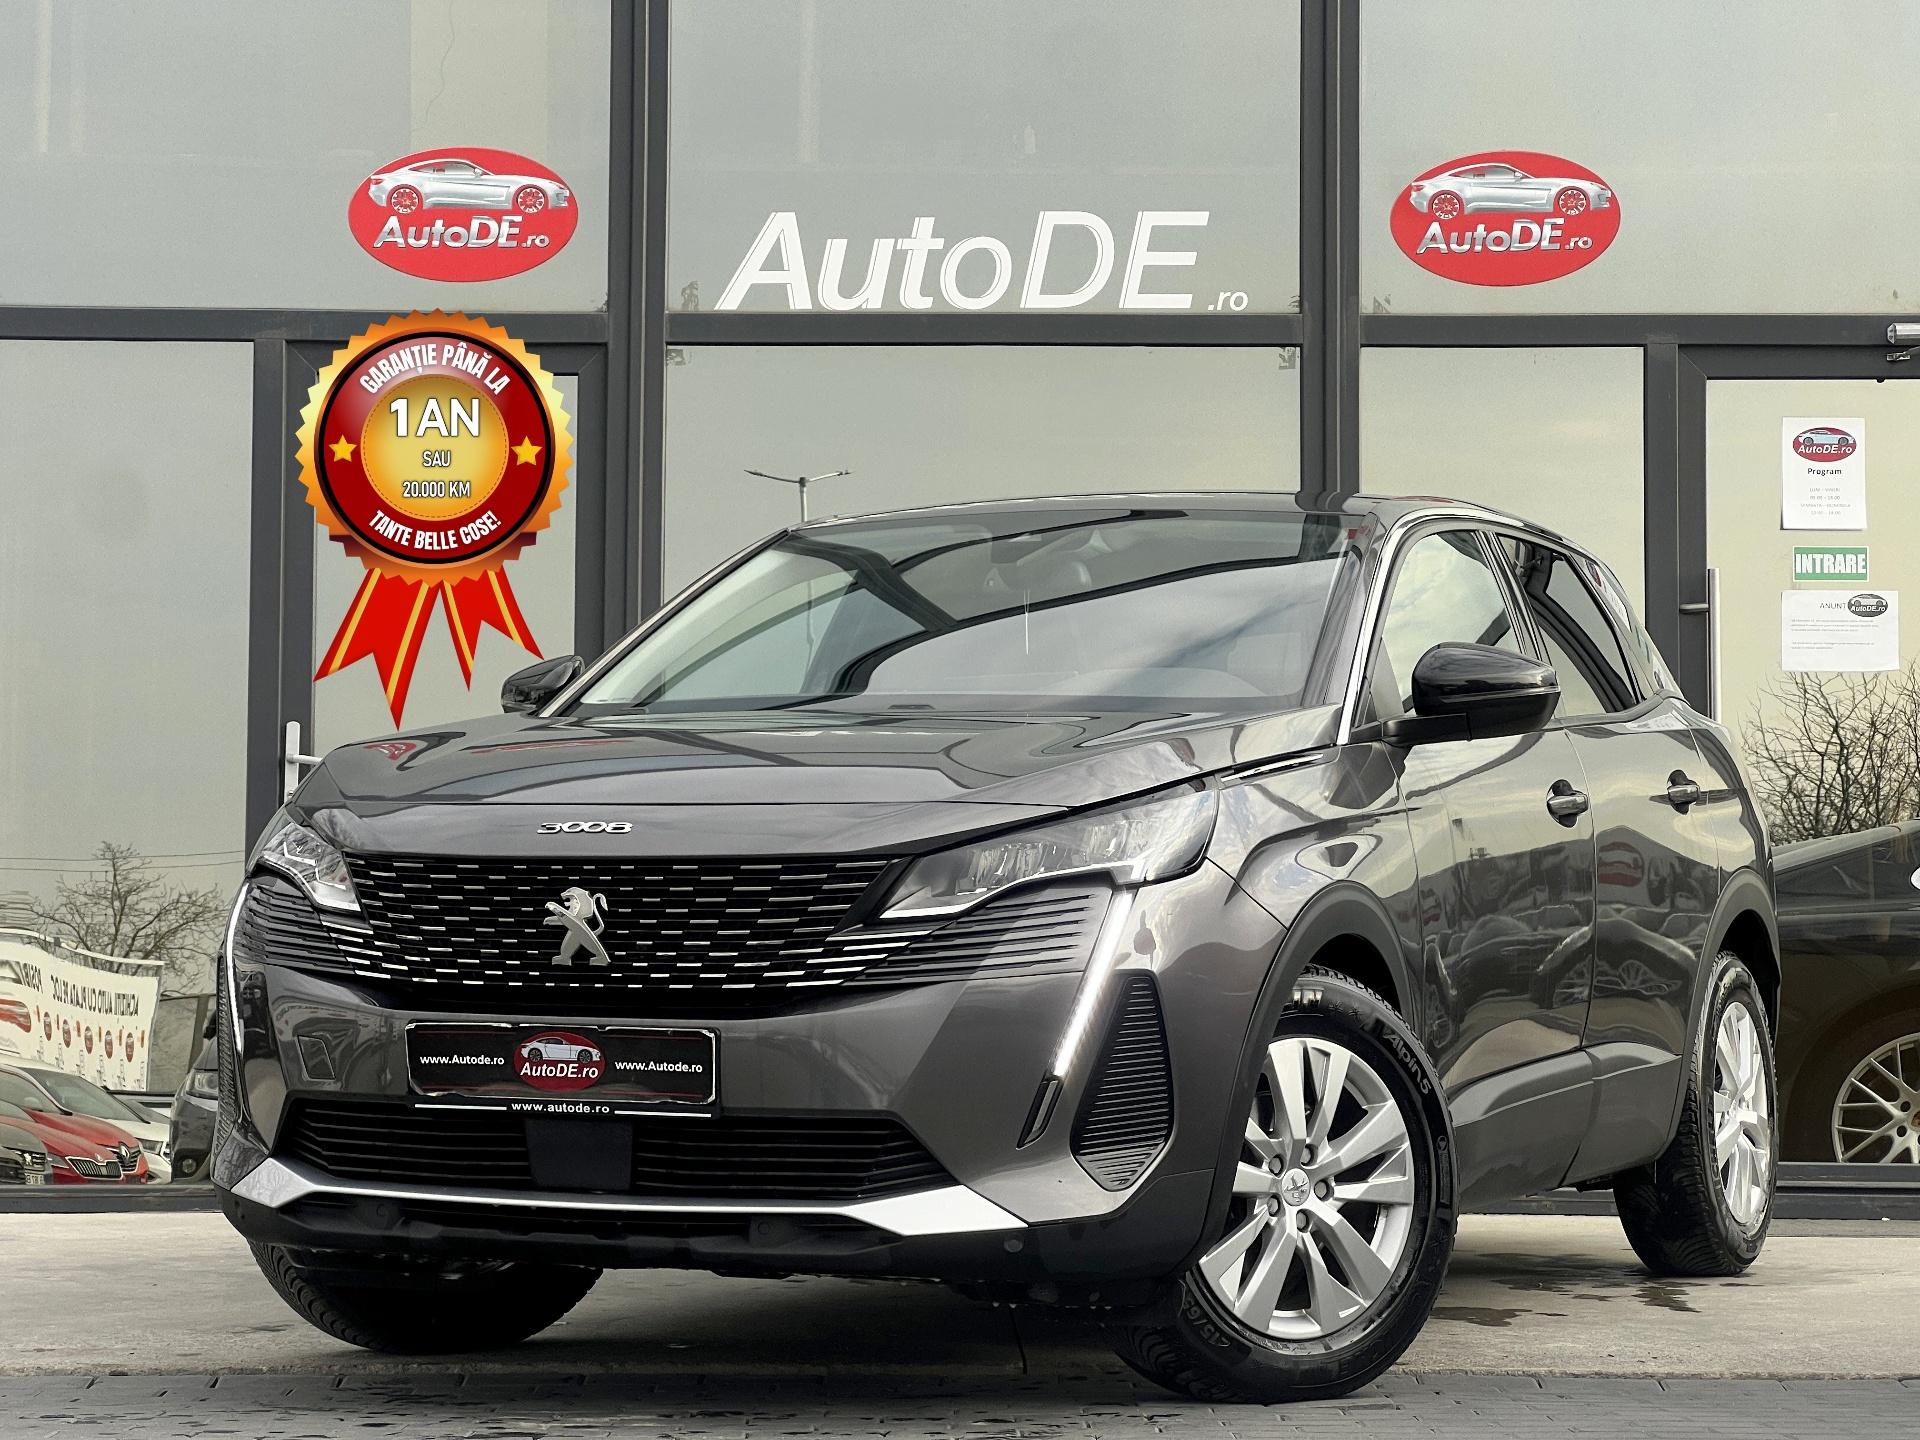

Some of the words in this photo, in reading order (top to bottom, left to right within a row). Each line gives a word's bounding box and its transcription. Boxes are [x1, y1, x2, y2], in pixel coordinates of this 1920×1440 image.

[1798, 444, 1853, 454] AutoDE.ro
[1807, 467, 1842, 476] Program
[1795, 553, 1866, 574] INTRARE
[537, 821, 633, 834] 3008
[419, 1054, 505, 1066] www.Autode.ro
[520, 1062, 599, 1079] AutoDE.ro
[614, 1060, 703, 1074] www.Autode.ro
[511, 1101, 610, 1114] www.autode.ro
